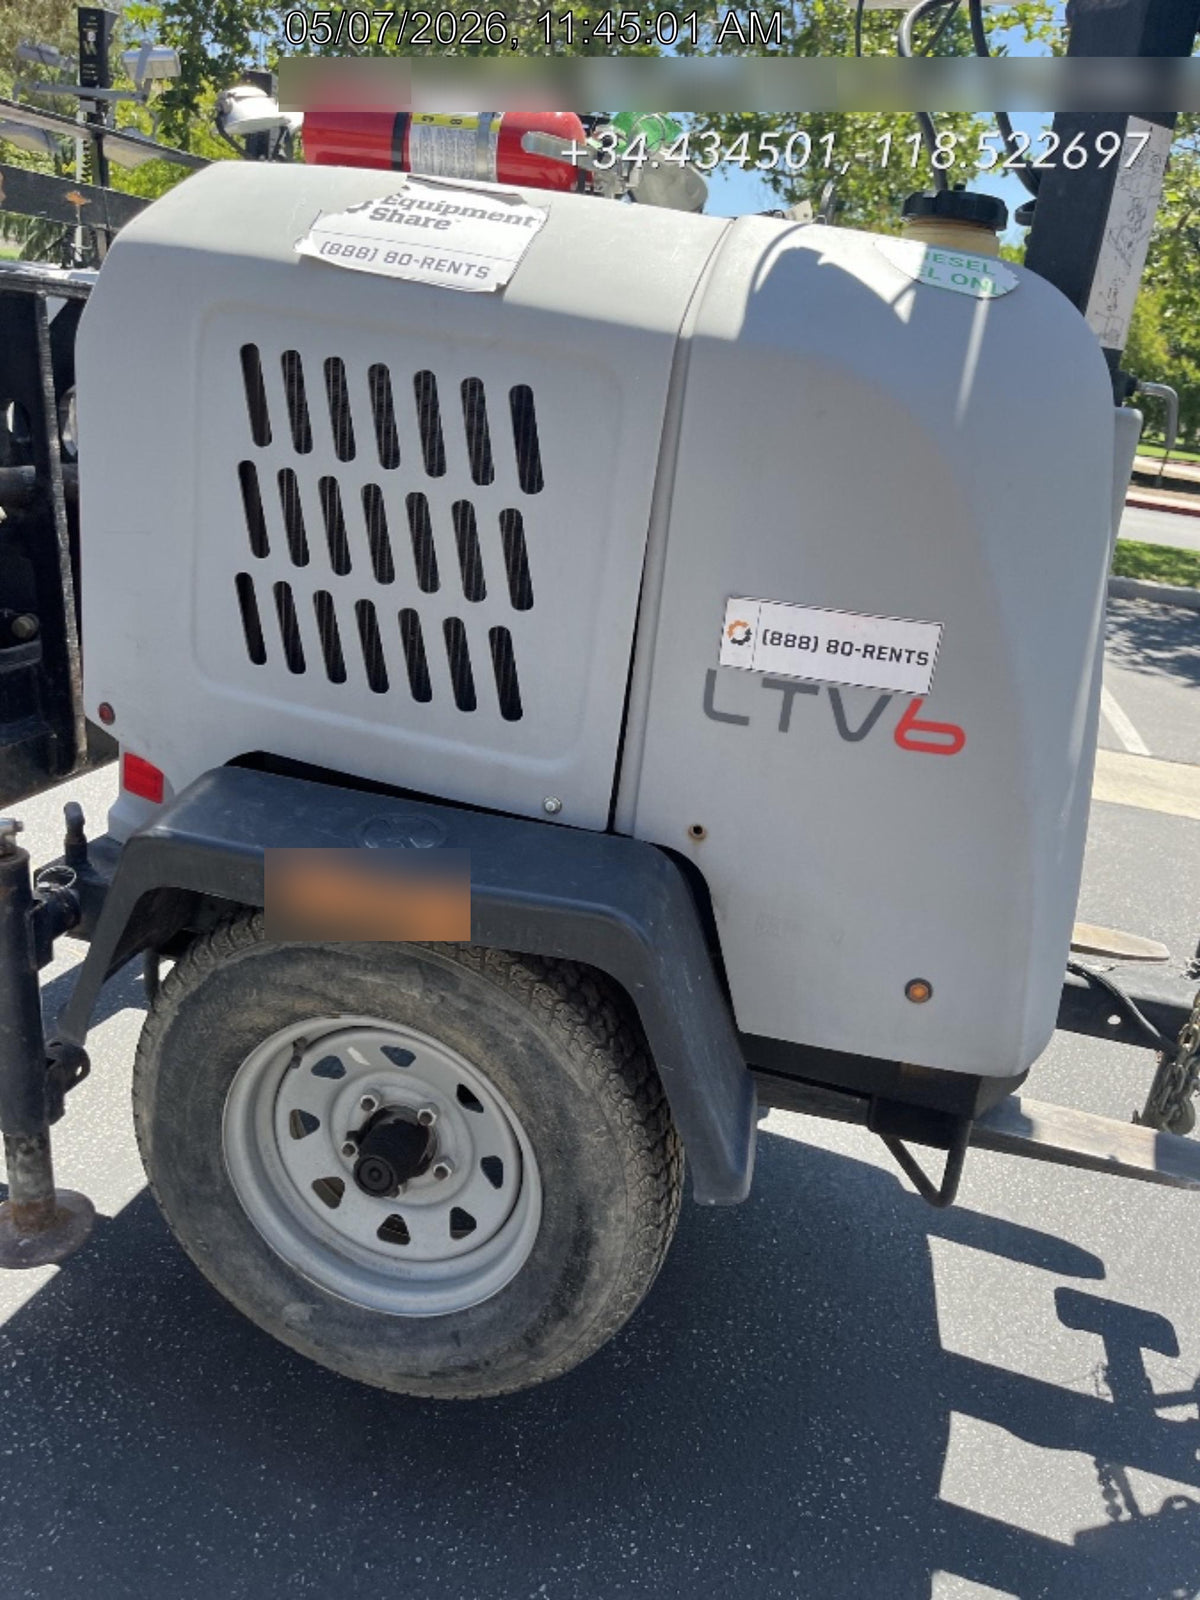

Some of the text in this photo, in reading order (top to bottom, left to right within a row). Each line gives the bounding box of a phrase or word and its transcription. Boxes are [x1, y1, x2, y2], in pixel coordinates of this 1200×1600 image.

[369, 207, 452, 230] Share
[381, 194, 537, 228] Equipment
[383, 251, 491, 280] 80-RENTS
[922, 250, 996, 276] IESEL
[761, 628, 930, 666] (888) 80-RENTS
[702, 668, 967, 757] LTV6
